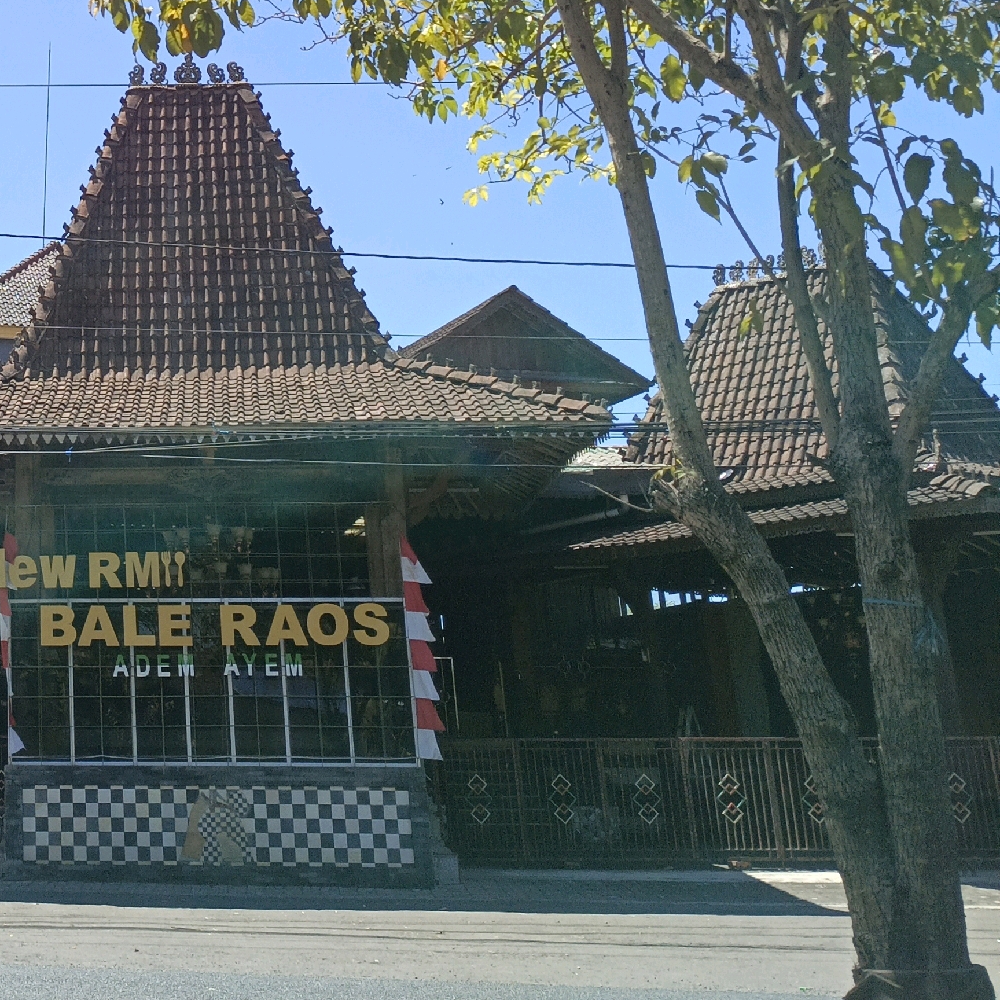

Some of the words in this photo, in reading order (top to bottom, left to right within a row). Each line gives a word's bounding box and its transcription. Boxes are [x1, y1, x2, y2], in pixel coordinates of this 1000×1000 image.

[88, 551, 161, 588] RM
[40, 603, 193, 647] BALE
[219, 602, 391, 646] RAOS
[112, 653, 195, 678] ADEM
[223, 653, 303, 677] AYEM
